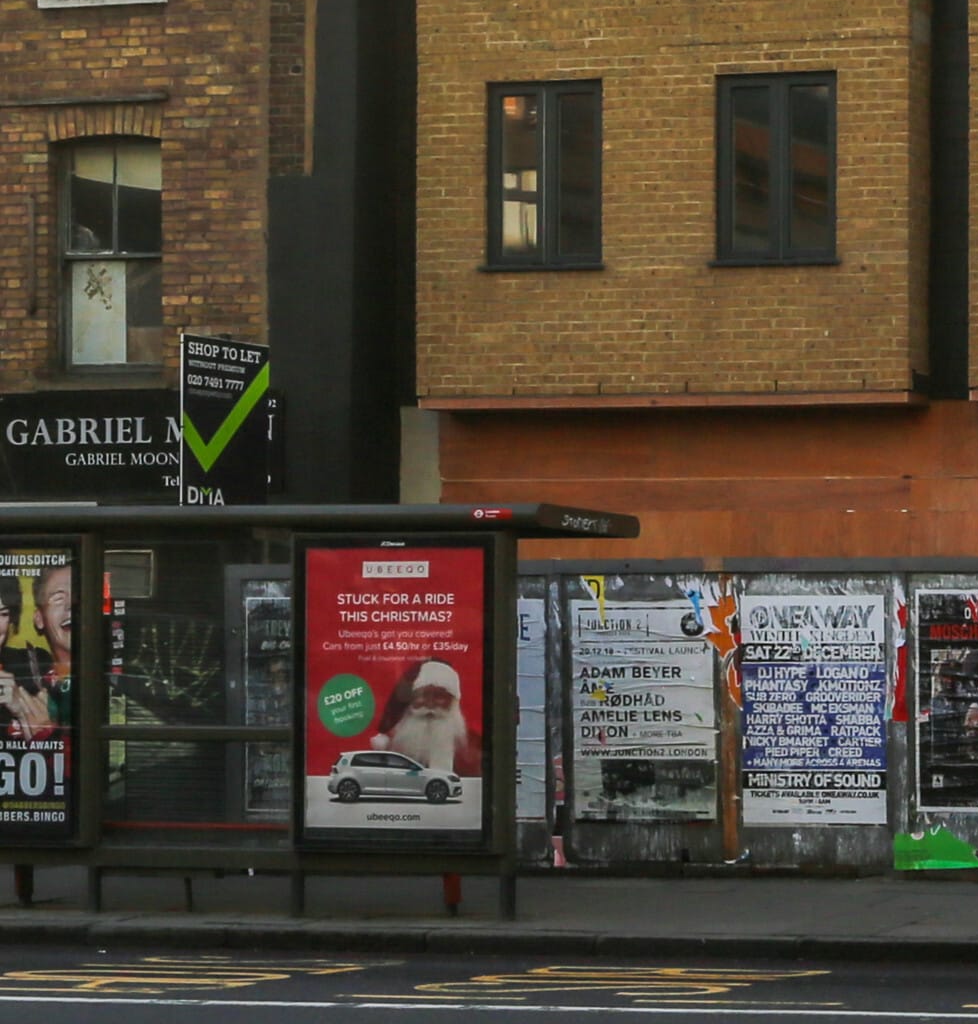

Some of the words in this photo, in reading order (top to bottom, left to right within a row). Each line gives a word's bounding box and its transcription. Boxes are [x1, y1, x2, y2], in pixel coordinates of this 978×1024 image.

[188, 341, 219, 359] SHOP
[222, 346, 238, 361] TO
[240, 350, 261, 364] LET
[187, 374, 202, 387] 020
[225, 379, 245, 392] 7777
[6, 417, 153, 446] GABRIEL
[65, 452, 125, 467] GABRIEL
[187, 486, 225, 506] DMA
[0, 568, 20, 577] GATE
[366, 564, 425, 574] UBEEQO
[337, 593, 379, 605] STUCK
[382, 593, 409, 605] FOR
[411, 593, 421, 605] A
[424, 593, 455, 605] RIDE
[339, 610, 368, 623] THIS
[371, 610, 452, 623] CHRISTMAS?
[323, 642, 342, 651] Cars
[745, 645, 772, 660] SAT
[803, 644, 881, 660] DECEMBER
[580, 666, 625, 679] ADAM
[632, 666, 681, 679] BEYER
[757, 667, 772, 679] DJ
[774, 667, 807, 679] HYPE
[816, 667, 857, 679] LOGAN
[745, 680, 808, 692] PHANTASY
[324, 691, 343, 706] £20
[343, 686, 363, 700] OFF
[769, 692, 797, 702] ZERO
[805, 692, 881, 703] GROOVERIDER
[811, 703, 828, 714] MC
[580, 710, 637, 722] AMELIE
[643, 710, 683, 723] LENS
[746, 714, 783, 725] HARRY
[785, 714, 827, 725] SHOTTA
[836, 714, 881, 725] SHABBA
[581, 725, 628, 738] DIXON
[746, 726, 774, 736] AZZA
[776, 726, 785, 736] &
[787, 726, 822, 736] GRIMA
[831, 726, 881, 737] RATPACK
[6, 740, 27, 750] HALL
[29, 740, 65, 750] AWAITS
[838, 737, 882, 748] CARTIER
[765, 747, 788, 758] PIED
[828, 747, 863, 758] CREED
[748, 773, 812, 788] MINISTRY
[814, 774, 832, 788] OF
[834, 774, 881, 788] SOUND
[0, 810, 65, 822] BERS.BINGO
[366, 813, 421, 823] ubeeqo.com
[415, 965, 832, 997] BUS
